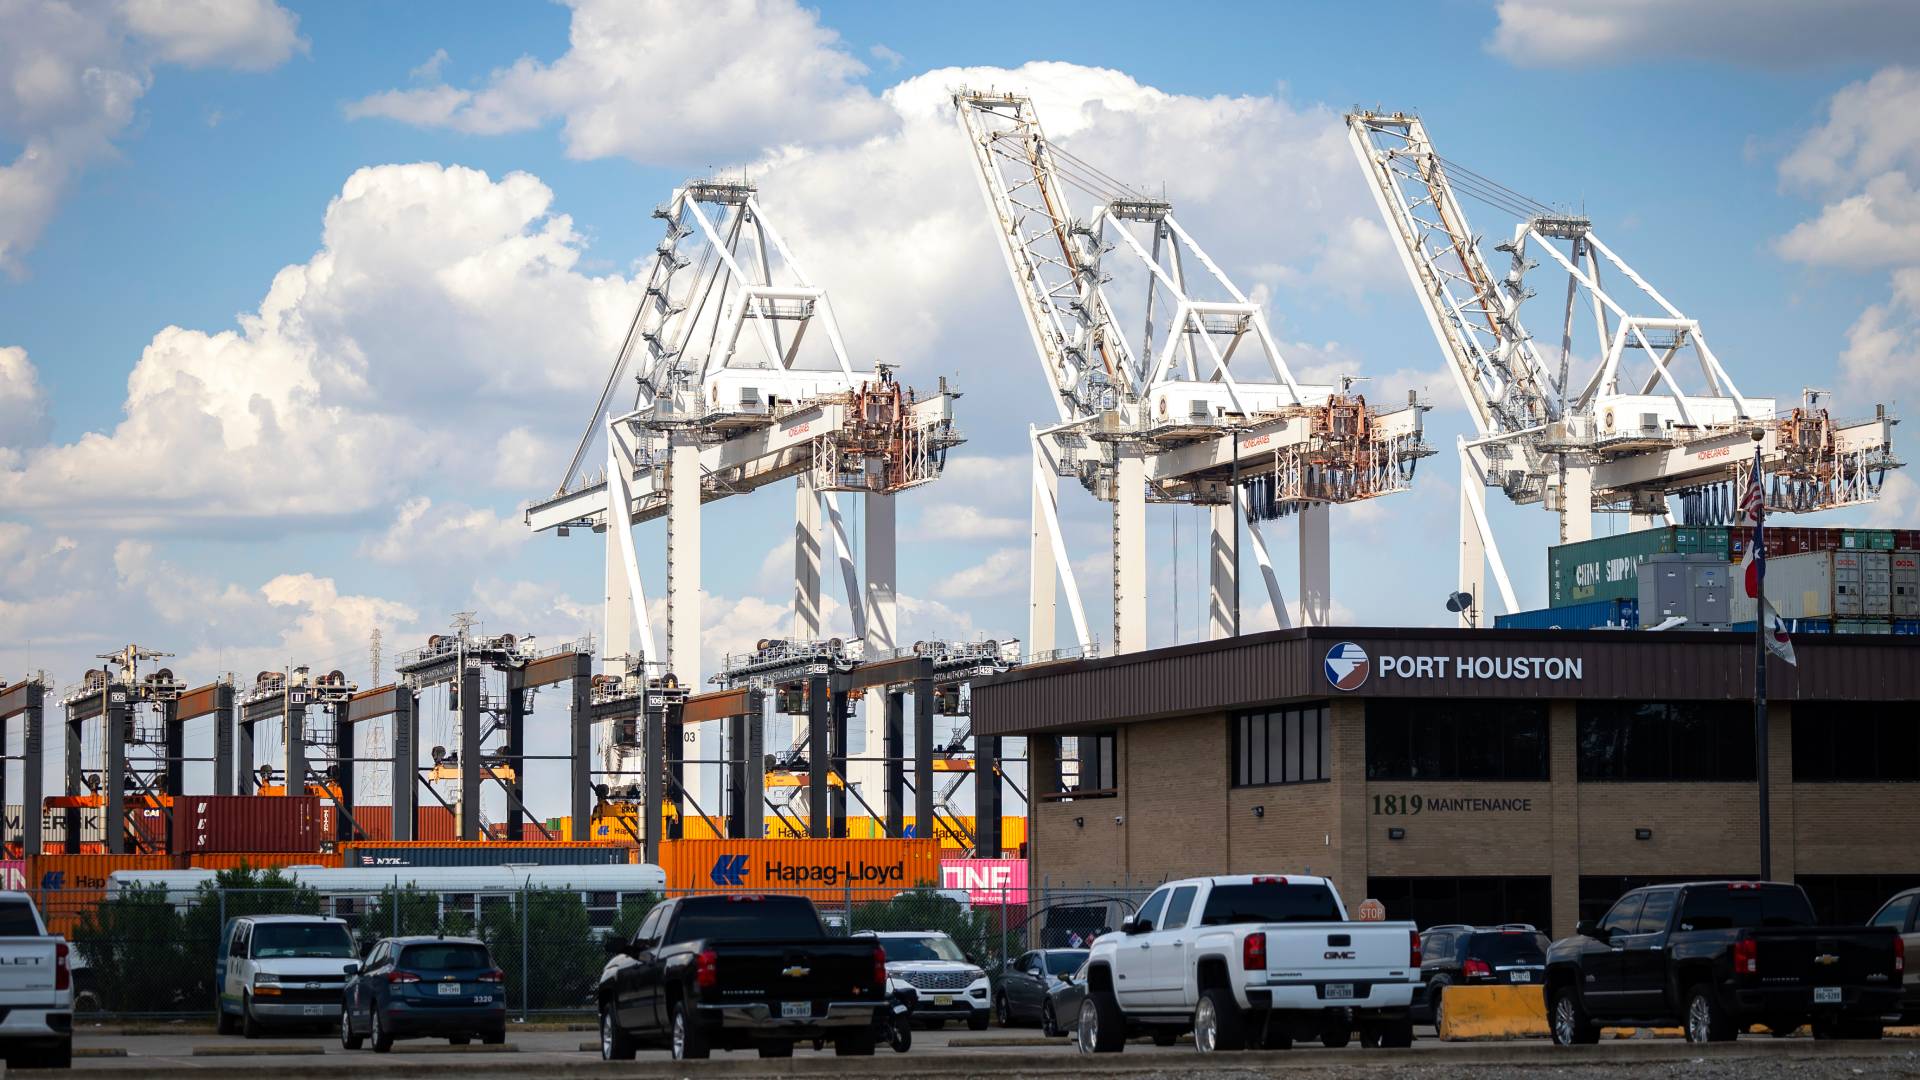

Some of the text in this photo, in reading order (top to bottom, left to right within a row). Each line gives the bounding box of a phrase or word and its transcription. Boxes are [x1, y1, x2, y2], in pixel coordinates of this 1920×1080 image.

[1575, 562, 1601, 586] CHINA
[1379, 655, 1582, 679] PORT HOUSTON
[1371, 794, 1532, 815] 1819 MAINTENANCE
[4, 815, 99, 830] MERK
[376, 857, 402, 865] NYK
[765, 860, 904, 886] Hapag-Lloyd
[1359, 907, 1383, 920] STOP
[1323, 951, 1356, 960] GMC
[473, 995, 493, 1003] 3320
